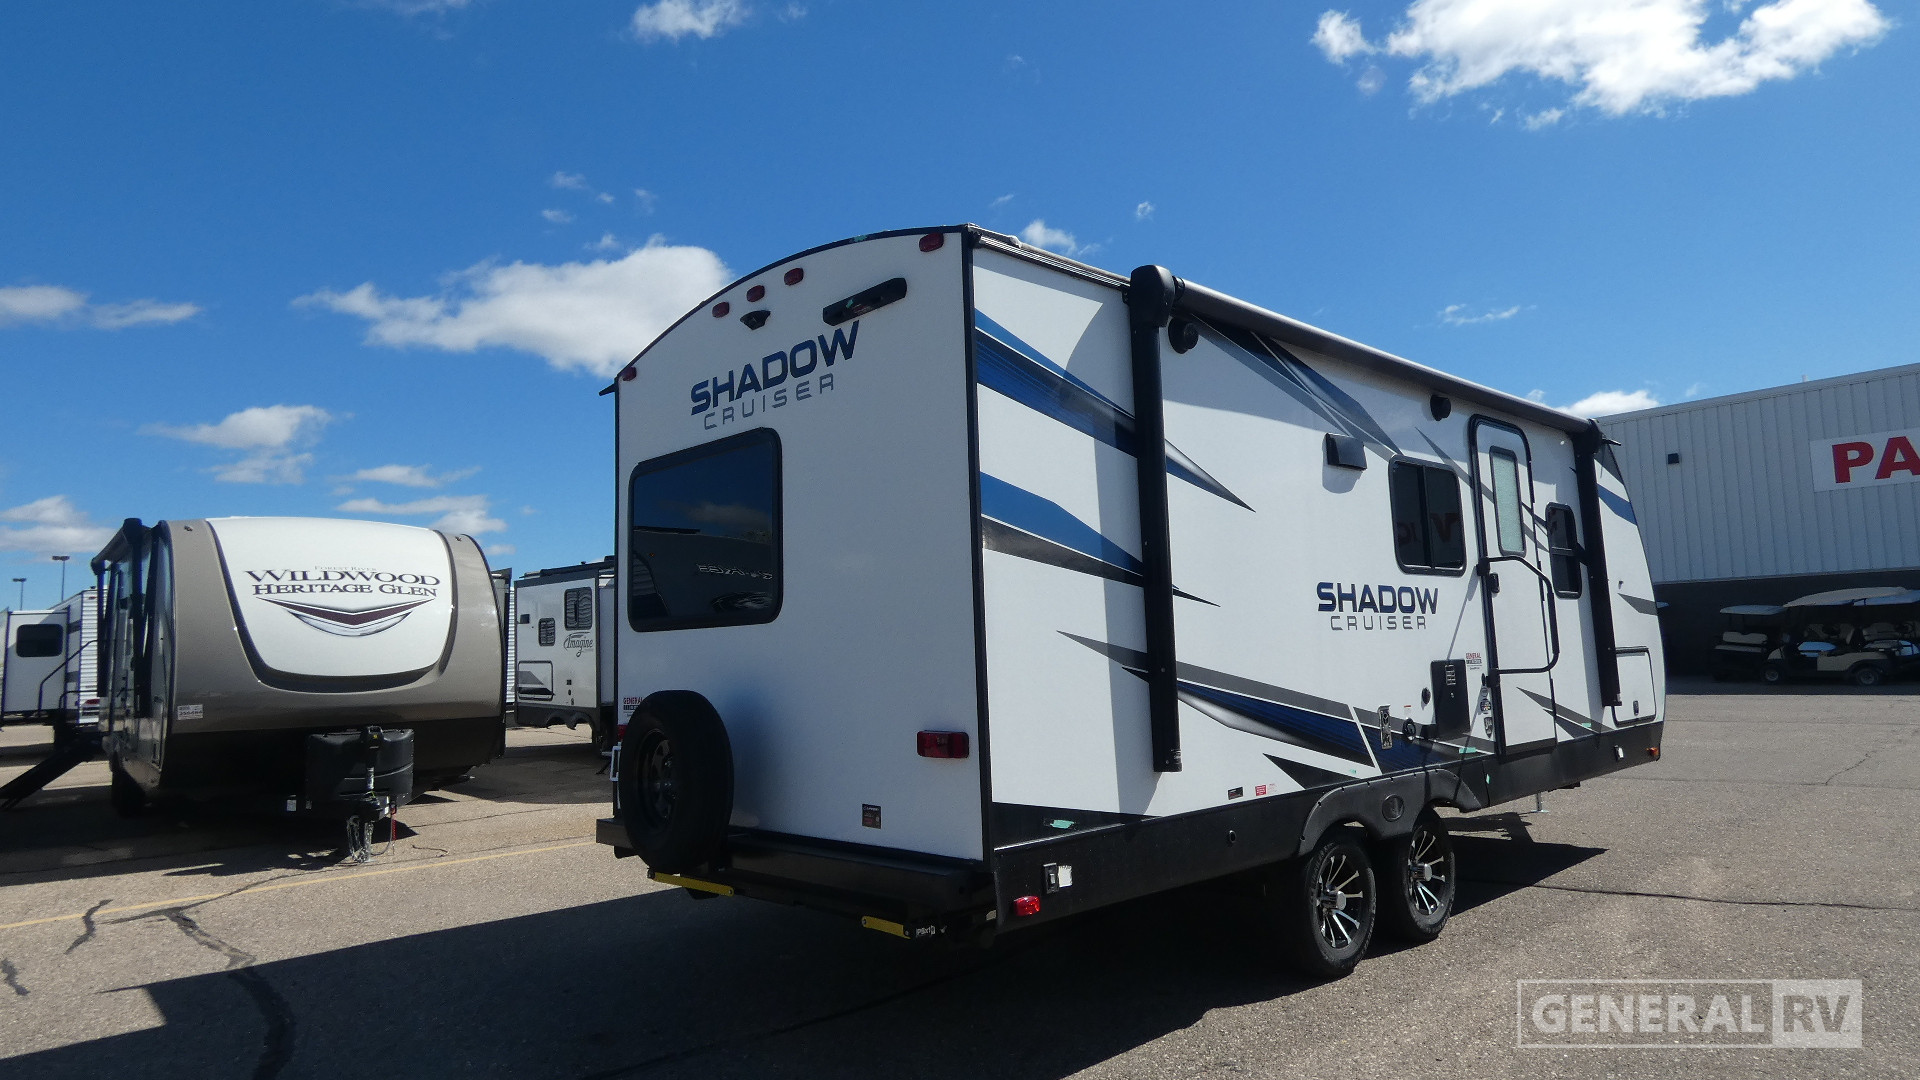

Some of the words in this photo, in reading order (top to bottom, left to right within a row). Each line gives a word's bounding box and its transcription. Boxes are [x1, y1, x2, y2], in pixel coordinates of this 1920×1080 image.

[691, 320, 859, 416] SHADOW
[704, 373, 834, 430] CRUISER
[1832, 436, 1920, 483] PA
[243, 569, 440, 586] WILDWOOD
[252, 584, 373, 596] HERITAGE
[378, 584, 438, 597] GLEN
[1316, 582, 1438, 614] SHADOW
[1330, 615, 1427, 630] CRUISER
[563, 633, 594, 657] Imagine
